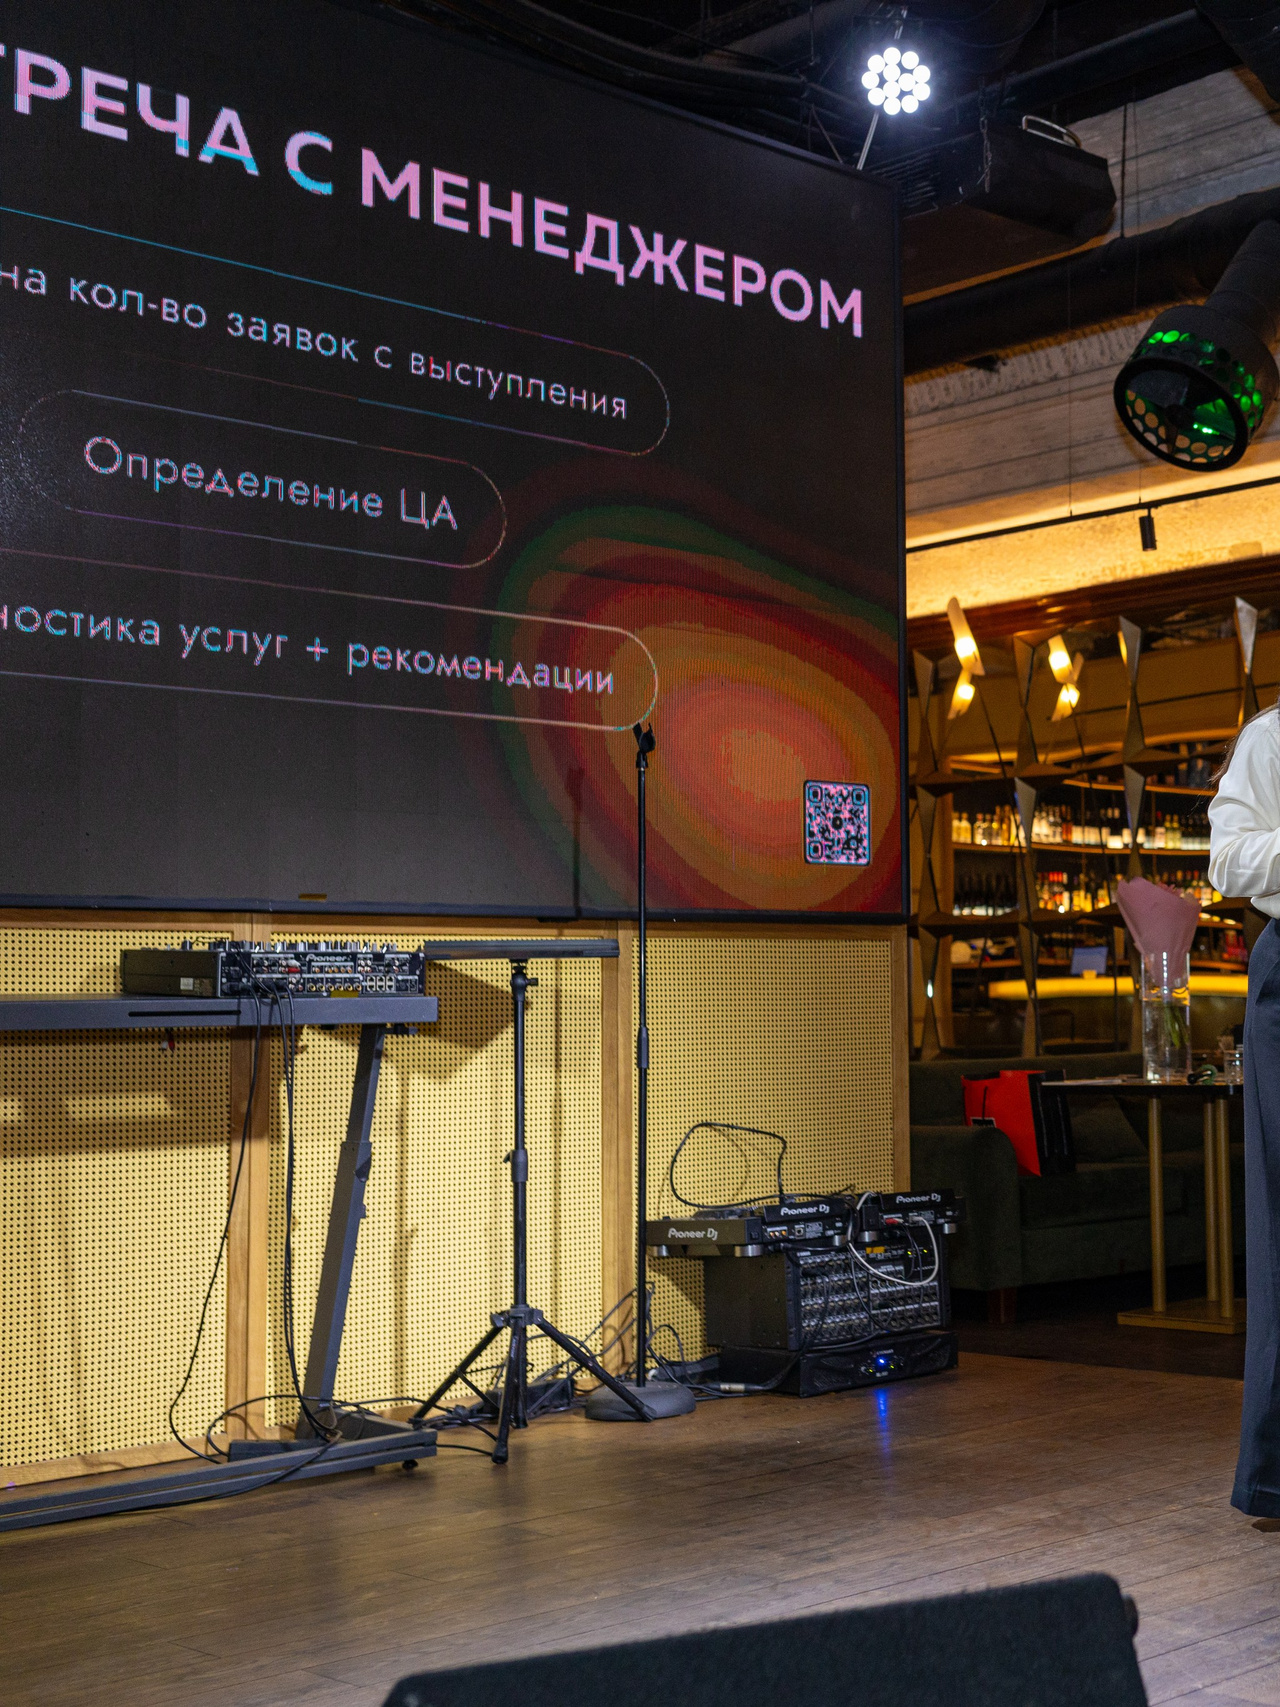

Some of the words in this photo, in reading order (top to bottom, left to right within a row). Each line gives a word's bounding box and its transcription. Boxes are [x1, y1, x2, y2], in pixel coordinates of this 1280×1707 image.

[0, 43, 259, 176] РЕЧА
[284, 130, 333, 195] С
[361, 147, 863, 338] МЕНЕДЖЕРОМ
[70, 277, 207, 328] кол-во
[227, 312, 359, 362] заявок
[374, 345, 393, 369] с
[410, 352, 627, 420] выступления
[84, 436, 383, 517] Определение
[400, 488, 458, 530] ЦА
[179, 623, 288, 666] услуг
[306, 637, 329, 662] +
[347, 642, 614, 694] рекомендации
[668, 1227, 706, 1239] Pioneer
[780, 1206, 818, 1216] Pioneer
